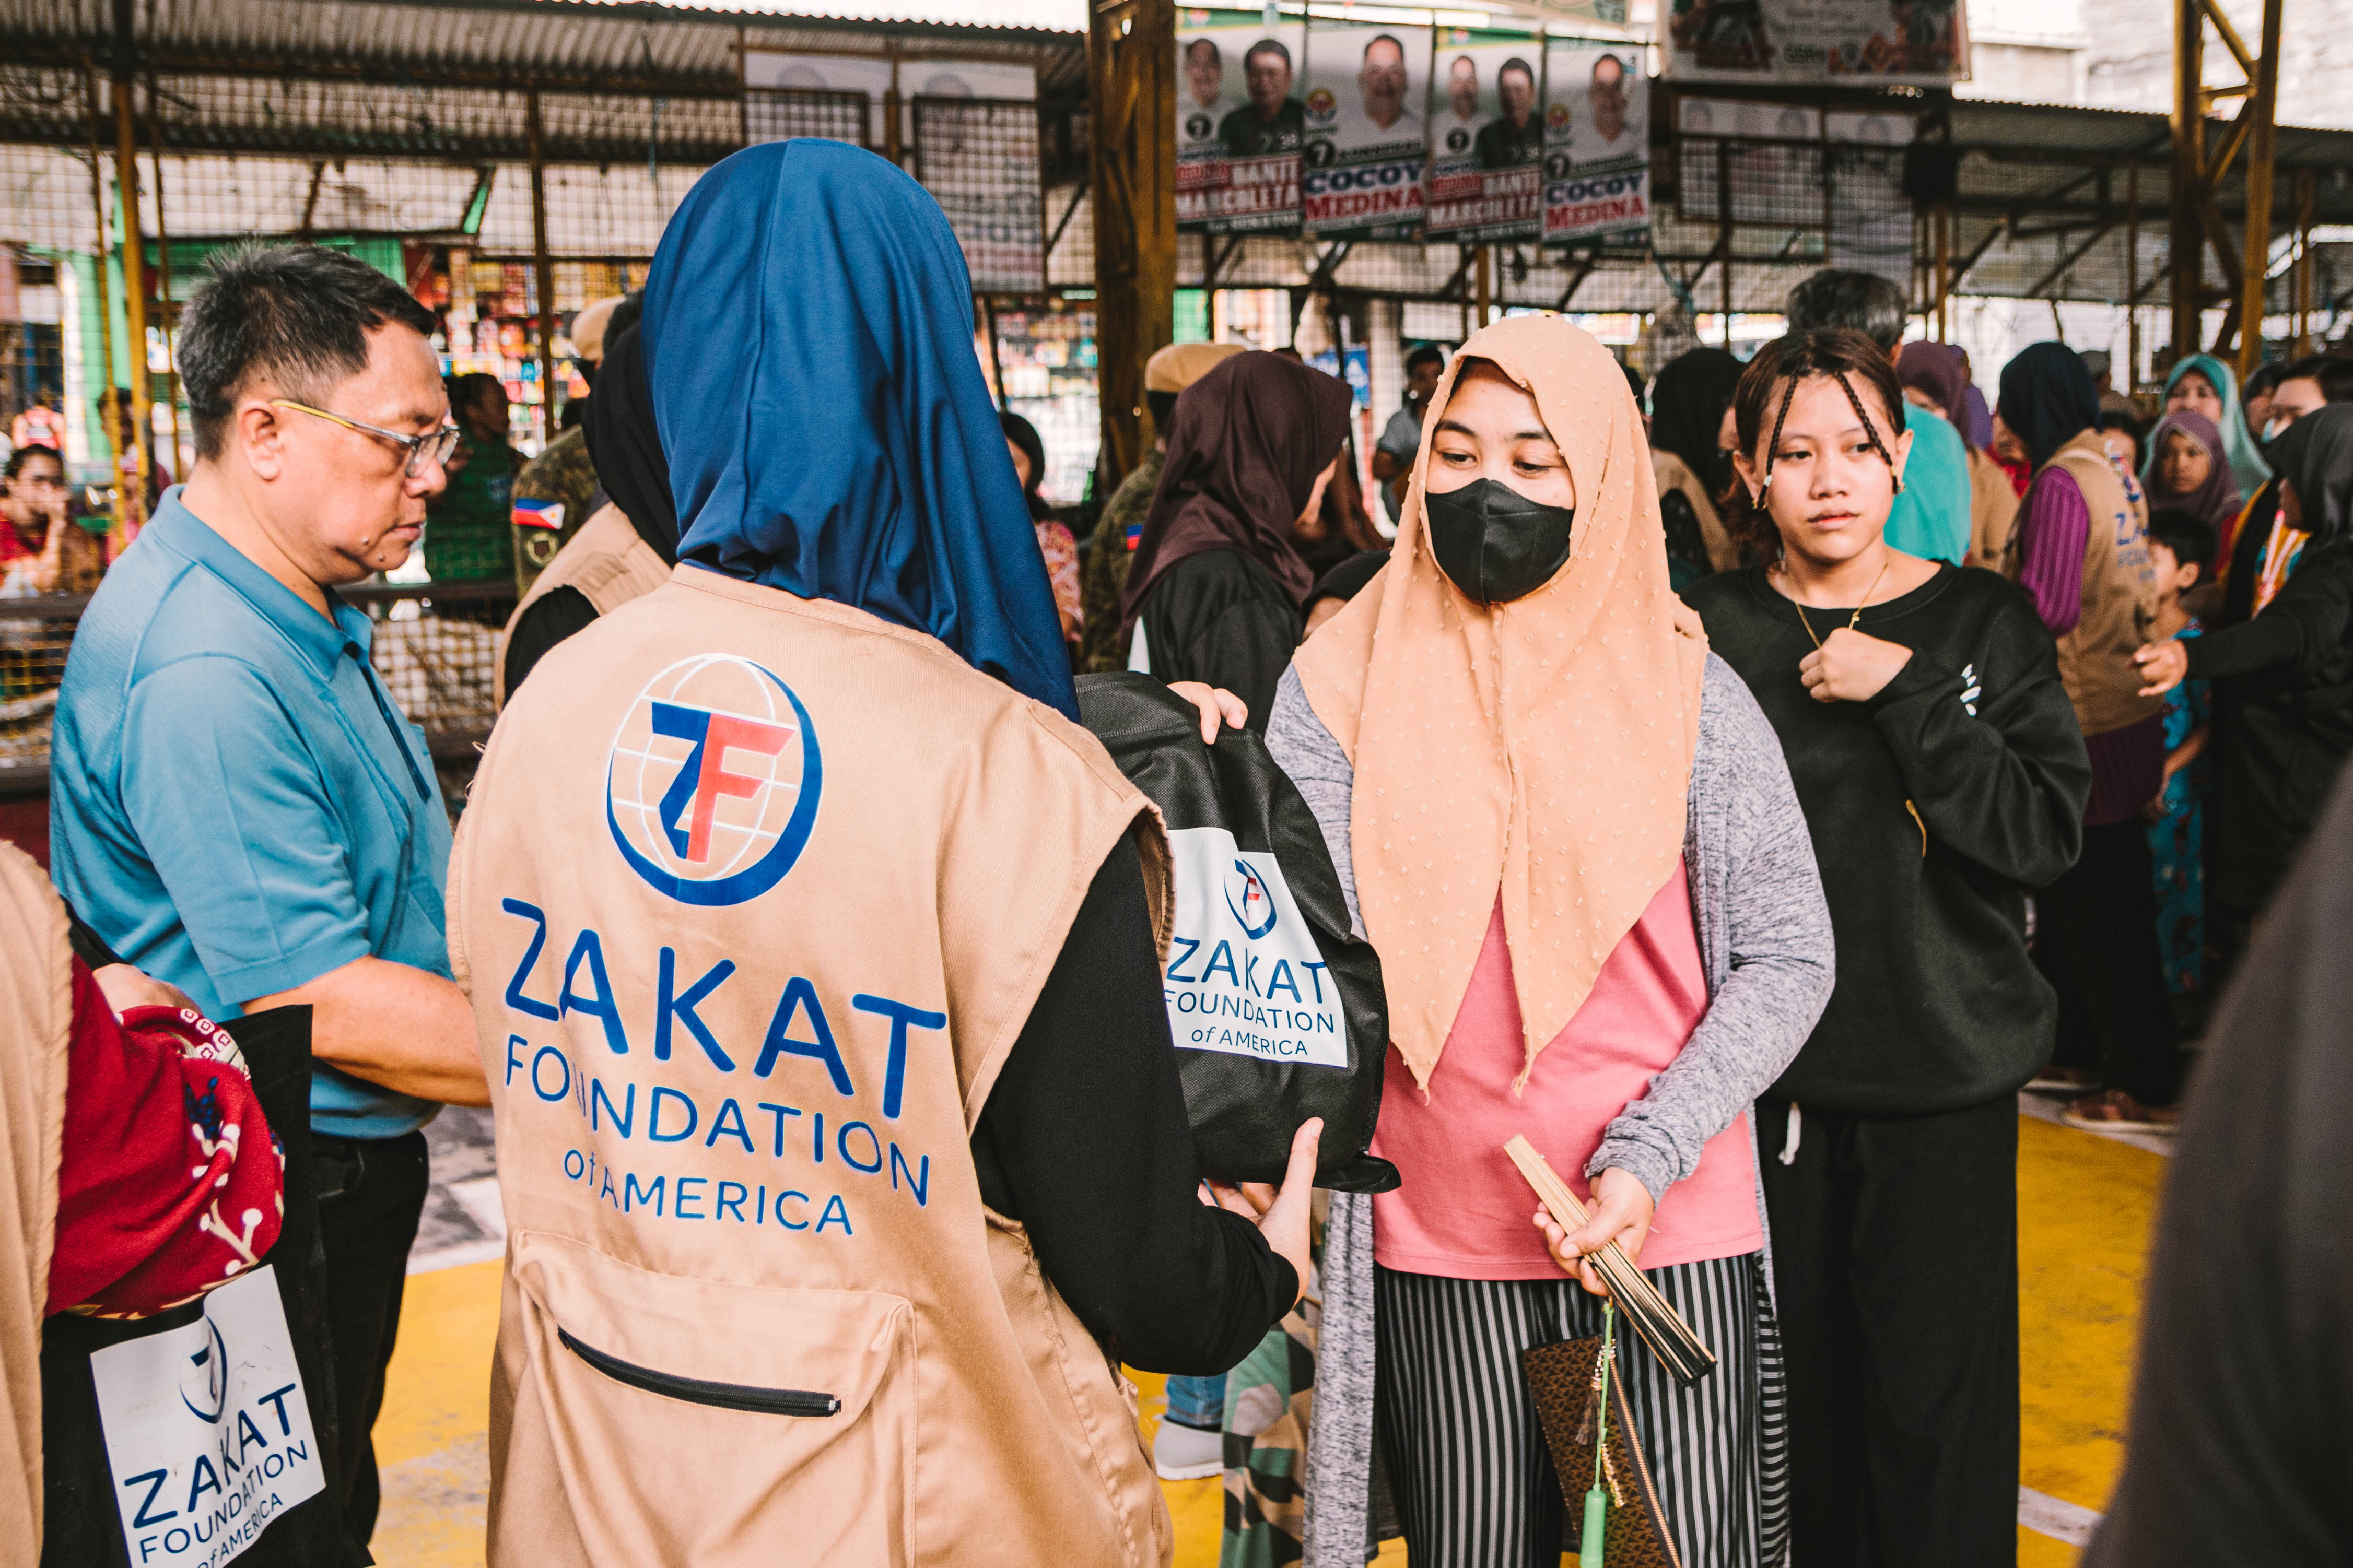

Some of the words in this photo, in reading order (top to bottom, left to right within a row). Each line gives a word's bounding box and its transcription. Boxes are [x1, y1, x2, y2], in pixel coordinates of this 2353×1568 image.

[1304, 162, 1426, 193] COCOY
[1312, 144, 1328, 164] 7
[1552, 157, 1566, 175] 7
[1304, 186, 1424, 220] MEDINA
[1547, 173, 1644, 203] COCOY
[1547, 194, 1645, 230] MEDINA
[1166, 936, 1328, 1004] ZAKAT
[502, 897, 947, 1120] ZAKAT
[1191, 1026, 1216, 1043] of
[1219, 1029, 1308, 1056] AMERICA
[506, 1033, 930, 1208] FOUNDATION
[600, 1165, 853, 1236] AMERICA
[124, 1382, 296, 1529] ZAKAT
[139, 1439, 308, 1563] FOUNDATION
[220, 1492, 284, 1562] AMERICA
